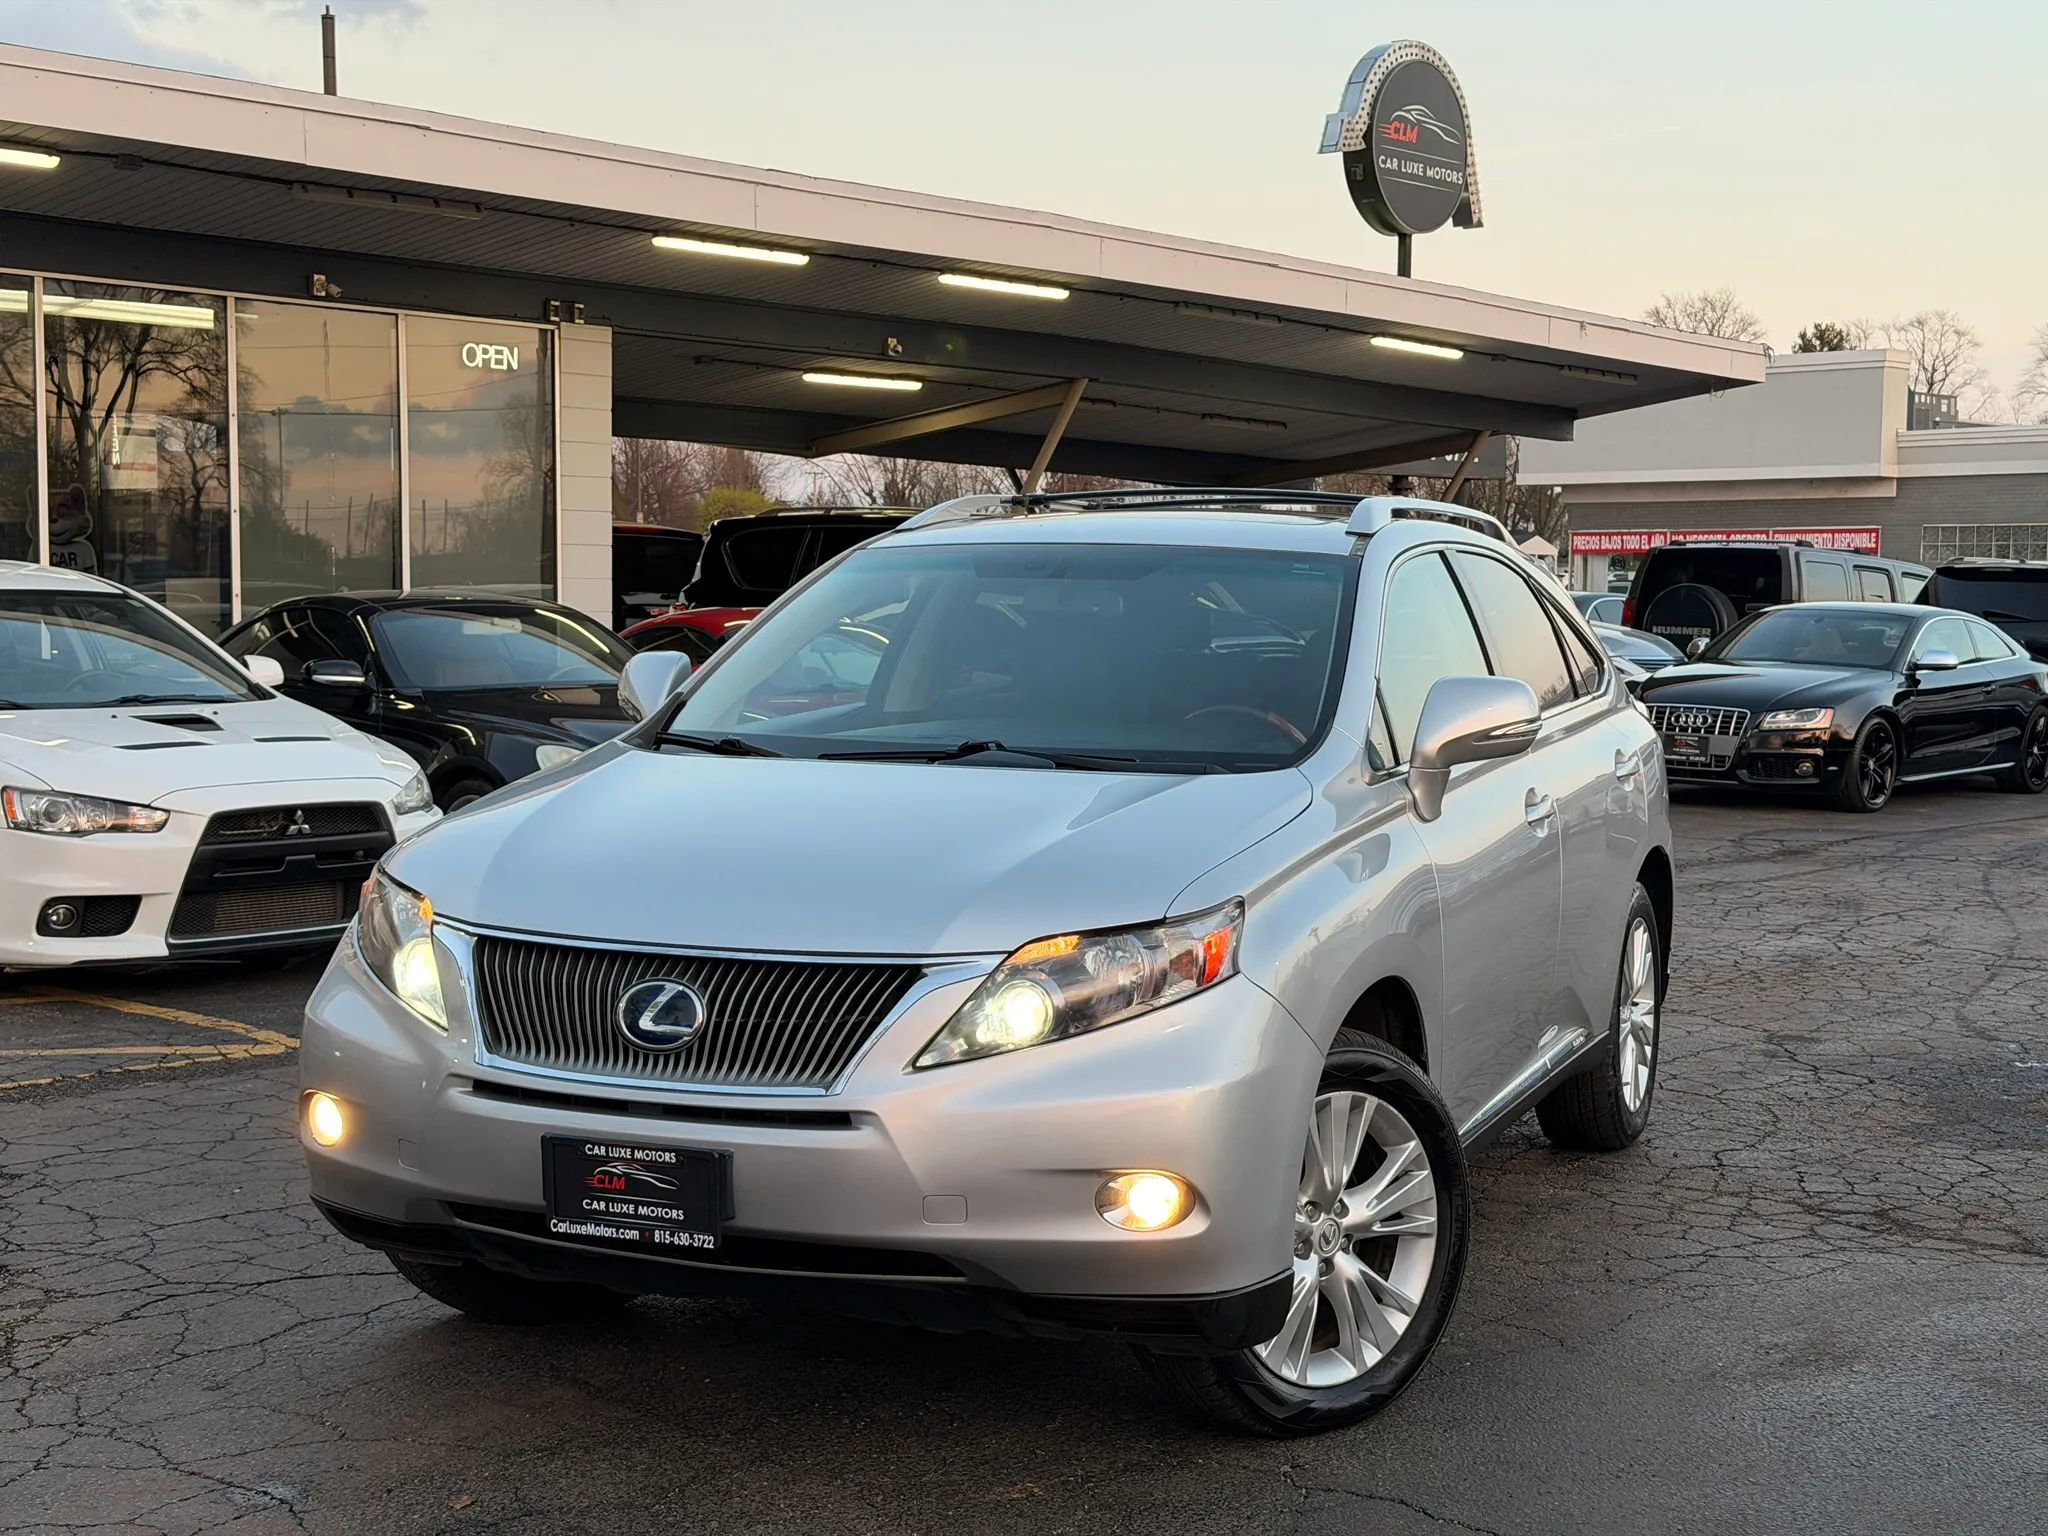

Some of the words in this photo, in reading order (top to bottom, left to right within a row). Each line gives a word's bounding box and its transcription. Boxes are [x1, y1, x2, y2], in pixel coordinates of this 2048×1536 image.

[1391, 120, 1419, 144] CLM
[1378, 155, 1399, 171] CAR
[1401, 159, 1425, 176] LUXE
[1426, 165, 1464, 184] MOTORS
[462, 342, 519, 370] OPEN
[1573, 535, 1600, 550] PRECIOS
[1600, 535, 1622, 550] BAJOS
[1622, 535, 1640, 550] TODO
[1641, 534, 1649, 550] EL
[1834, 532, 1877, 548] DISPONIBLE
[51, 551, 78, 568] CAR
[1652, 625, 1711, 635] HUMMER
[584, 1144, 606, 1156] CAR
[608, 1146, 632, 1159] LUXE
[634, 1149, 677, 1163] MOTORS
[594, 1174, 626, 1190] CLM
[582, 1199, 606, 1211] CAR
[609, 1202, 635, 1214] LUXE
[637, 1205, 685, 1220] MOTORS
[550, 1219, 640, 1240] CarLuxeMotors.com
[654, 1229, 715, 1249] 815-630-3722
